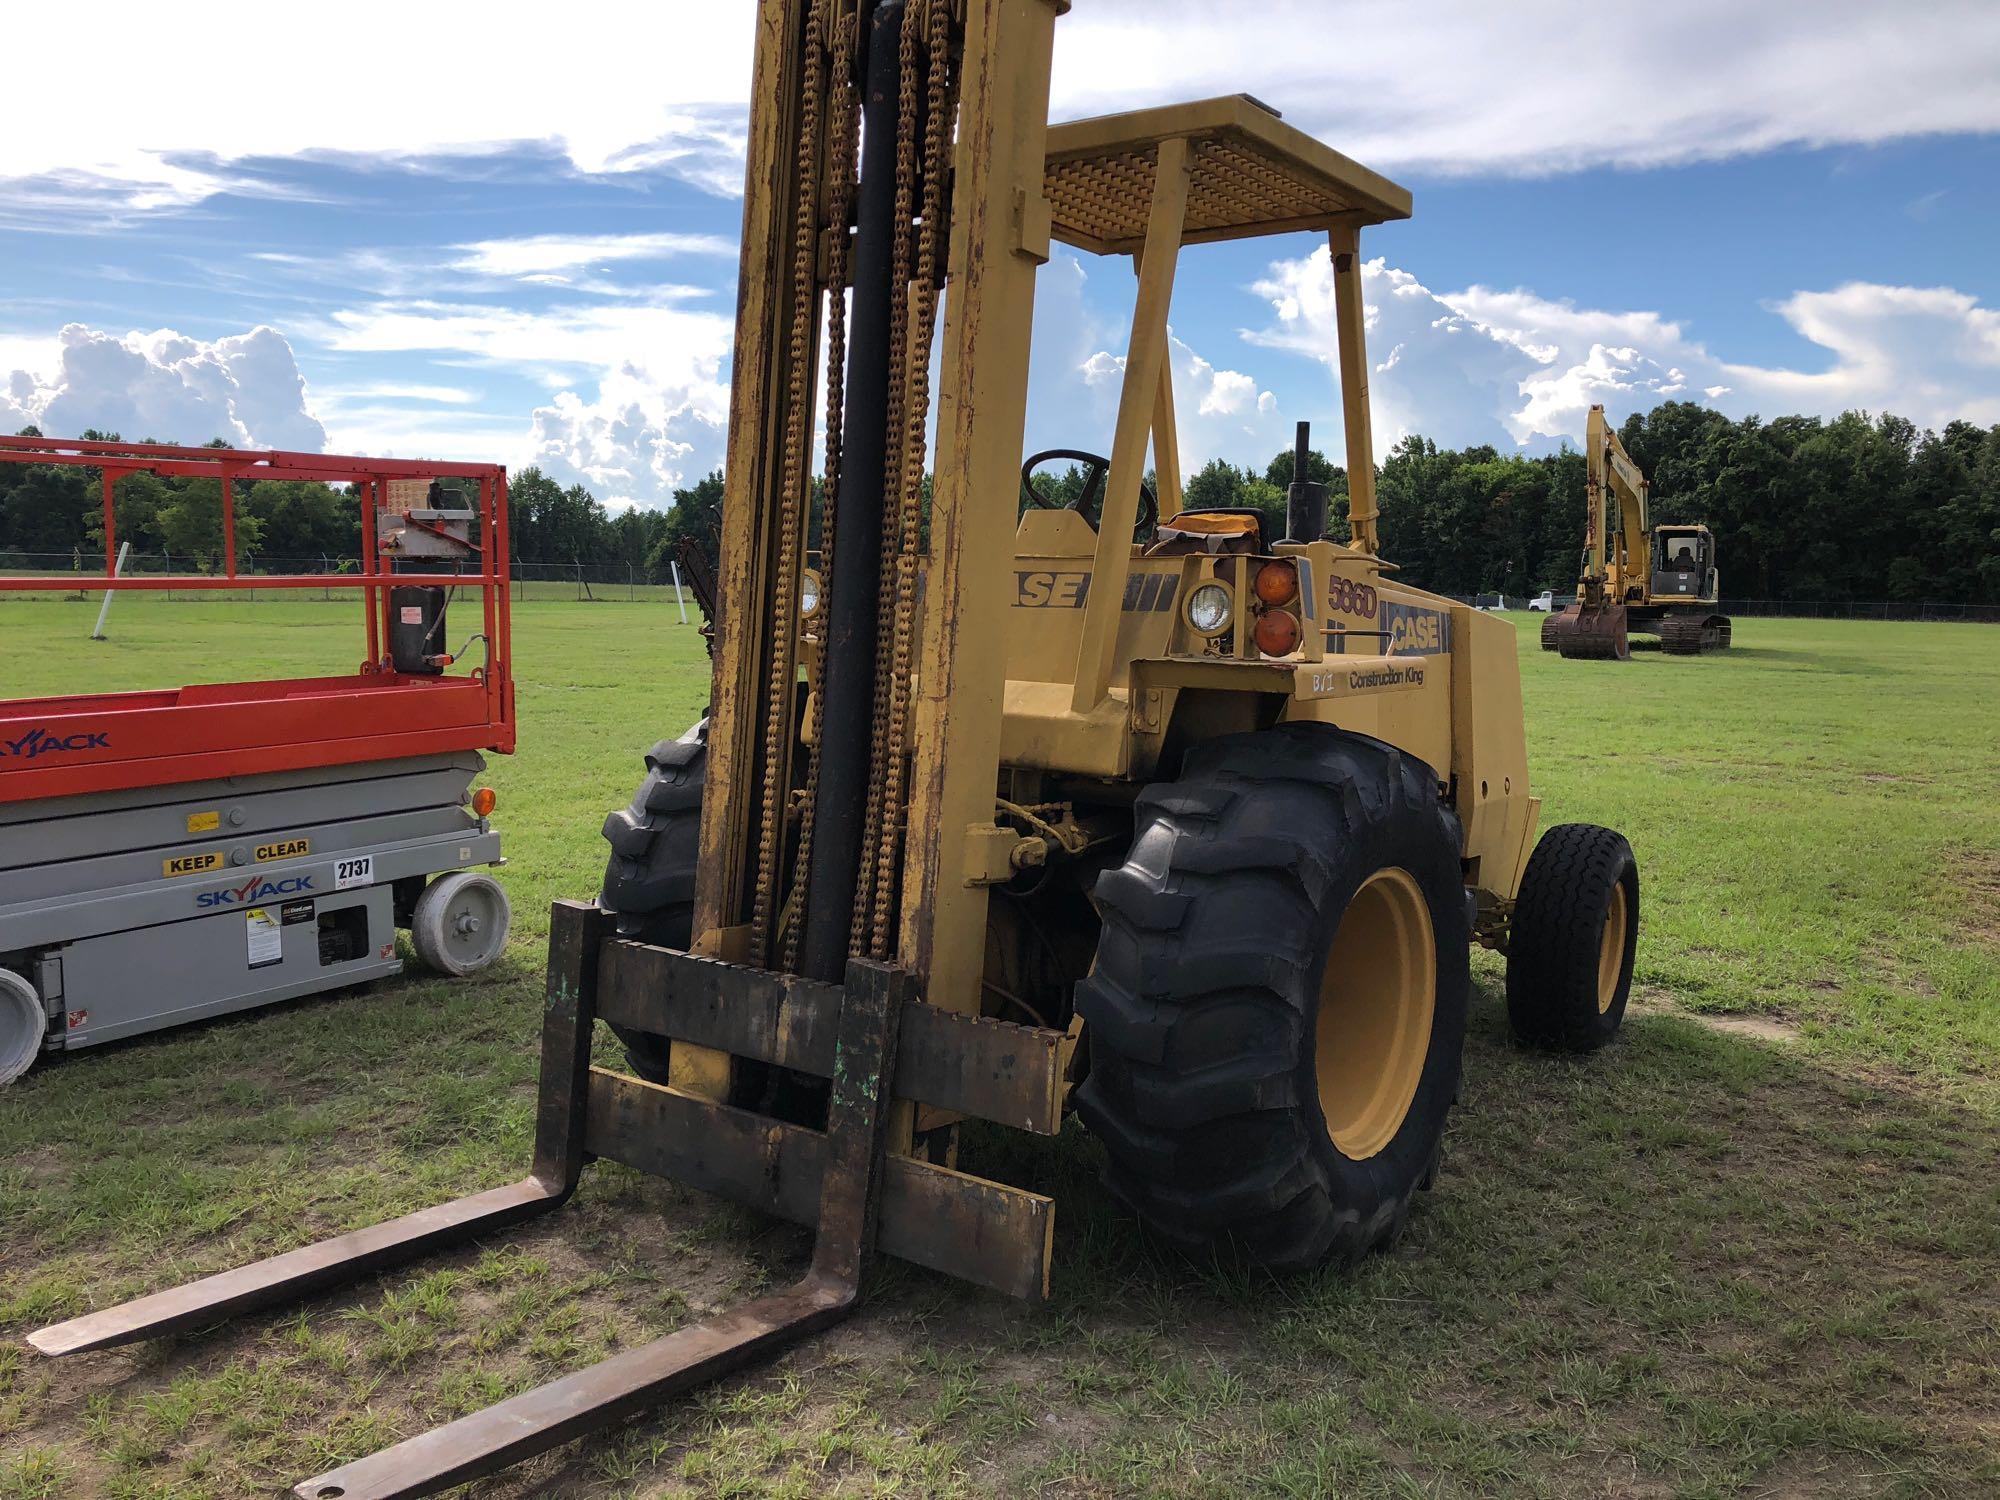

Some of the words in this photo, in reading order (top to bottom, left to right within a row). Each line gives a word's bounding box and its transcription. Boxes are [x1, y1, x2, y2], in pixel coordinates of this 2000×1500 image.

[1013, 571, 1085, 607] SE
[1328, 574, 1377, 619] 586D
[1391, 615, 1439, 651] CASE
[1350, 669, 1403, 689] Construction
[1405, 667, 1424, 685] King
[0, 728, 112, 758] YJACK
[170, 855, 216, 873] KEEP
[256, 841, 307, 860] CLEAR
[338, 858, 369, 879] 2737
[196, 876, 315, 908] SKYJACK
